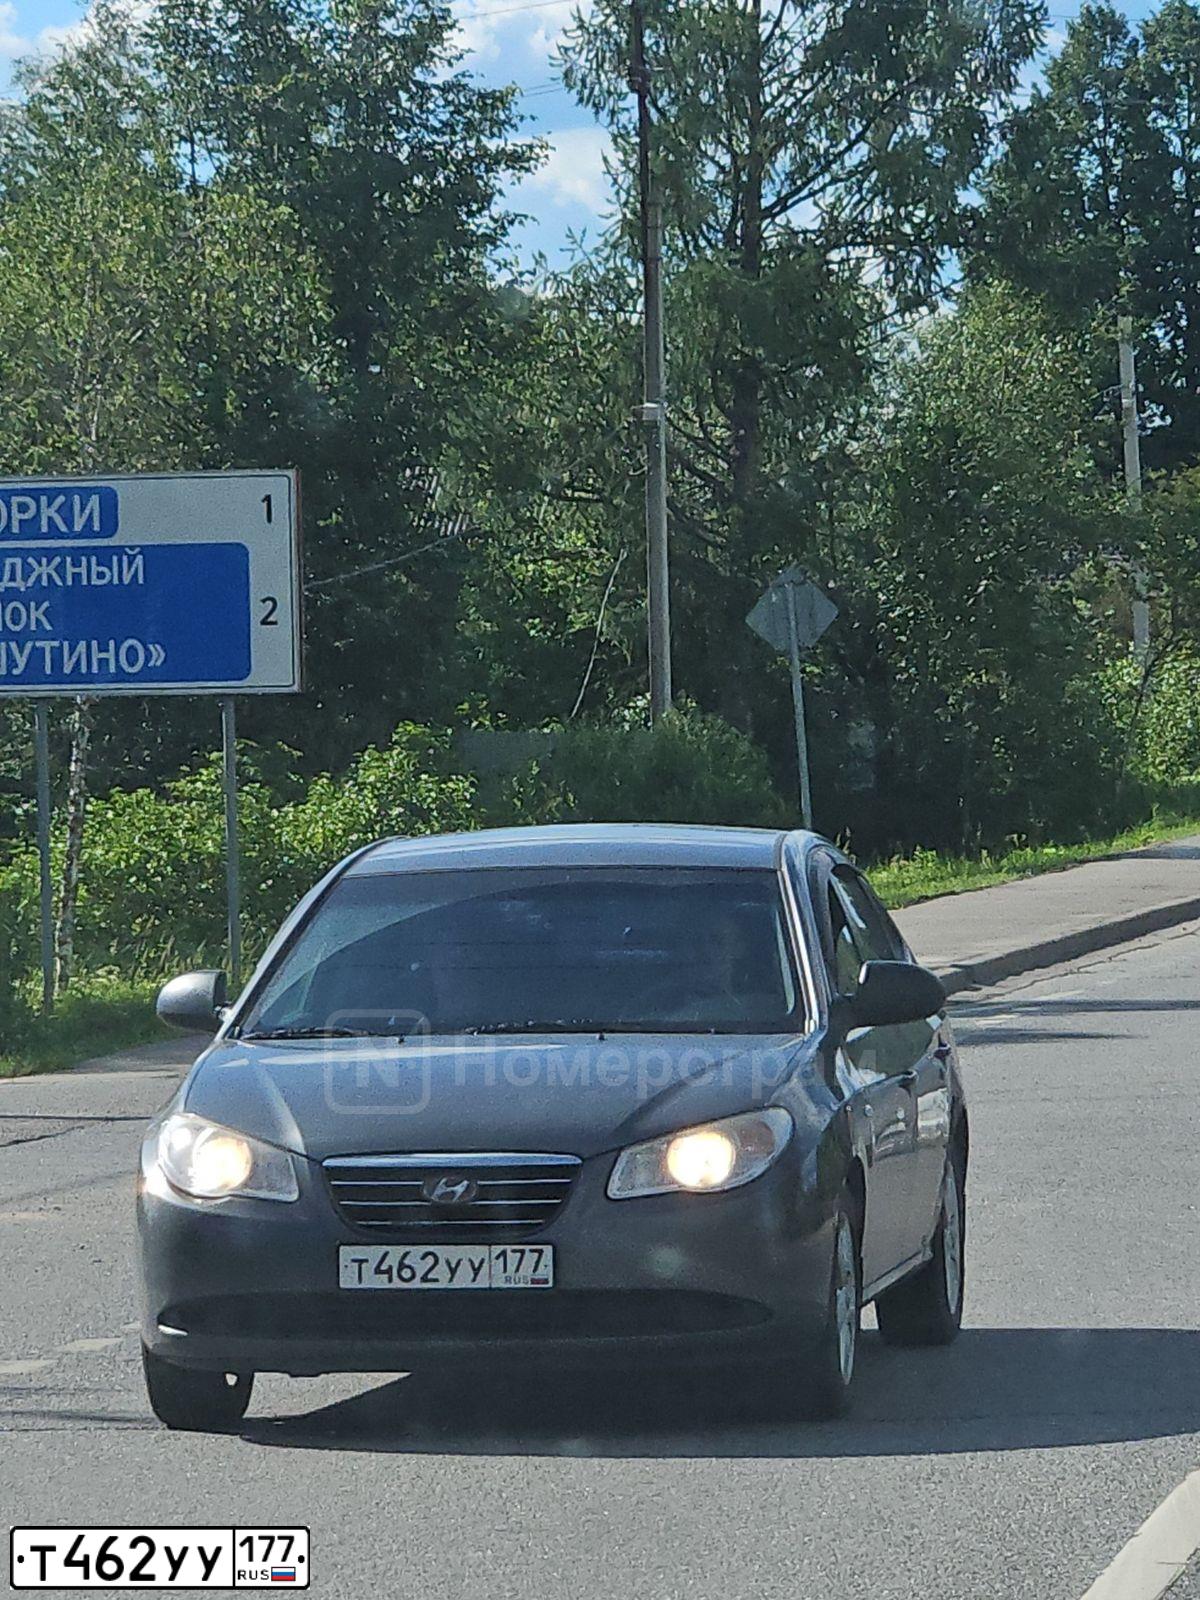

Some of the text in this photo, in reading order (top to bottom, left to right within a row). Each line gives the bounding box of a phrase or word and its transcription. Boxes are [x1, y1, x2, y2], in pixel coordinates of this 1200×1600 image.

[0, 494, 101, 533] РКИ
[260, 494, 273, 524] 1
[0, 547, 145, 592] ДЖНЫЙ
[0, 600, 53, 631] ОК
[259, 596, 279, 626] 2
[351, 1248, 544, 1284] Т462УУ 177
[503, 1275, 530, 1286] RUS
